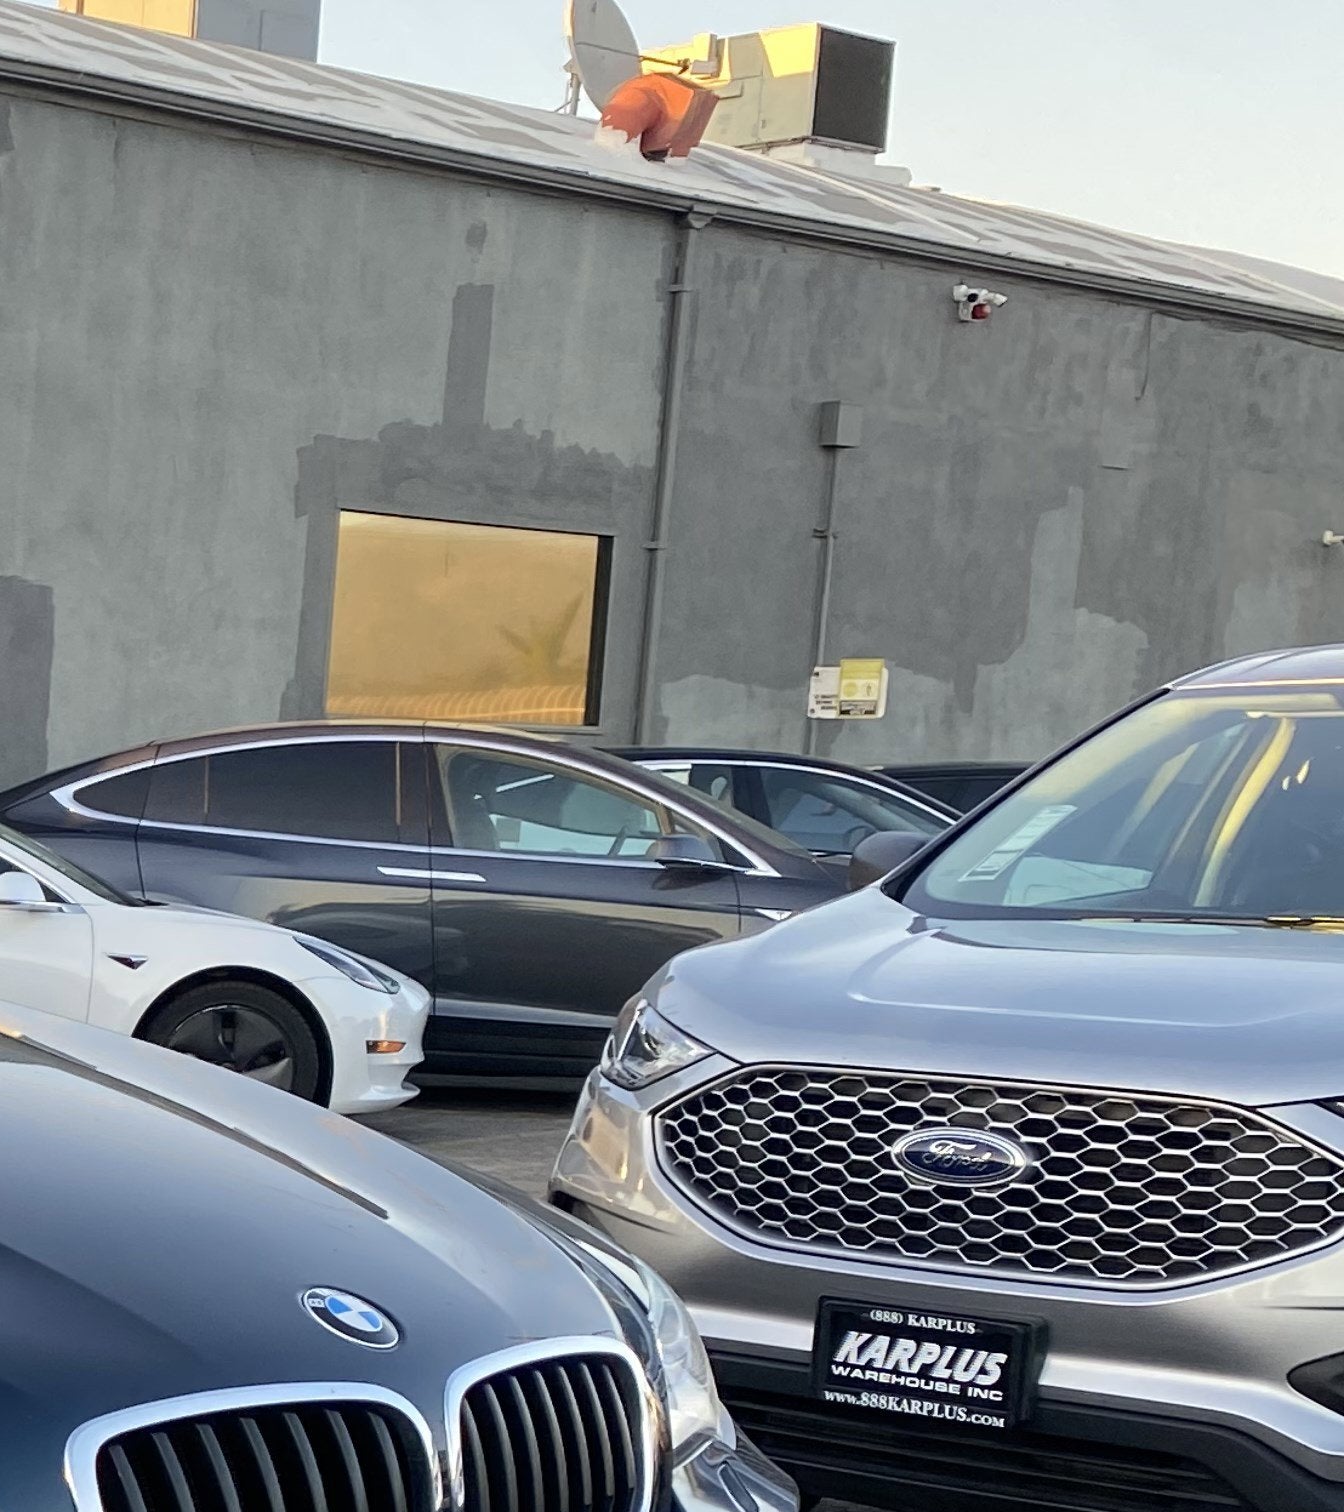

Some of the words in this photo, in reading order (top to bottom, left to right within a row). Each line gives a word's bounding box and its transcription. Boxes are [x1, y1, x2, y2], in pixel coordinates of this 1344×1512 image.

[922, 1139, 992, 1172] Ford
[869, 1309, 904, 1324] (888)
[907, 1314, 976, 1335] KARPLUS
[832, 1330, 1009, 1386] KARPLUS
[830, 1364, 961, 1395] WAREHOUSE
[967, 1386, 1004, 1401] INC
